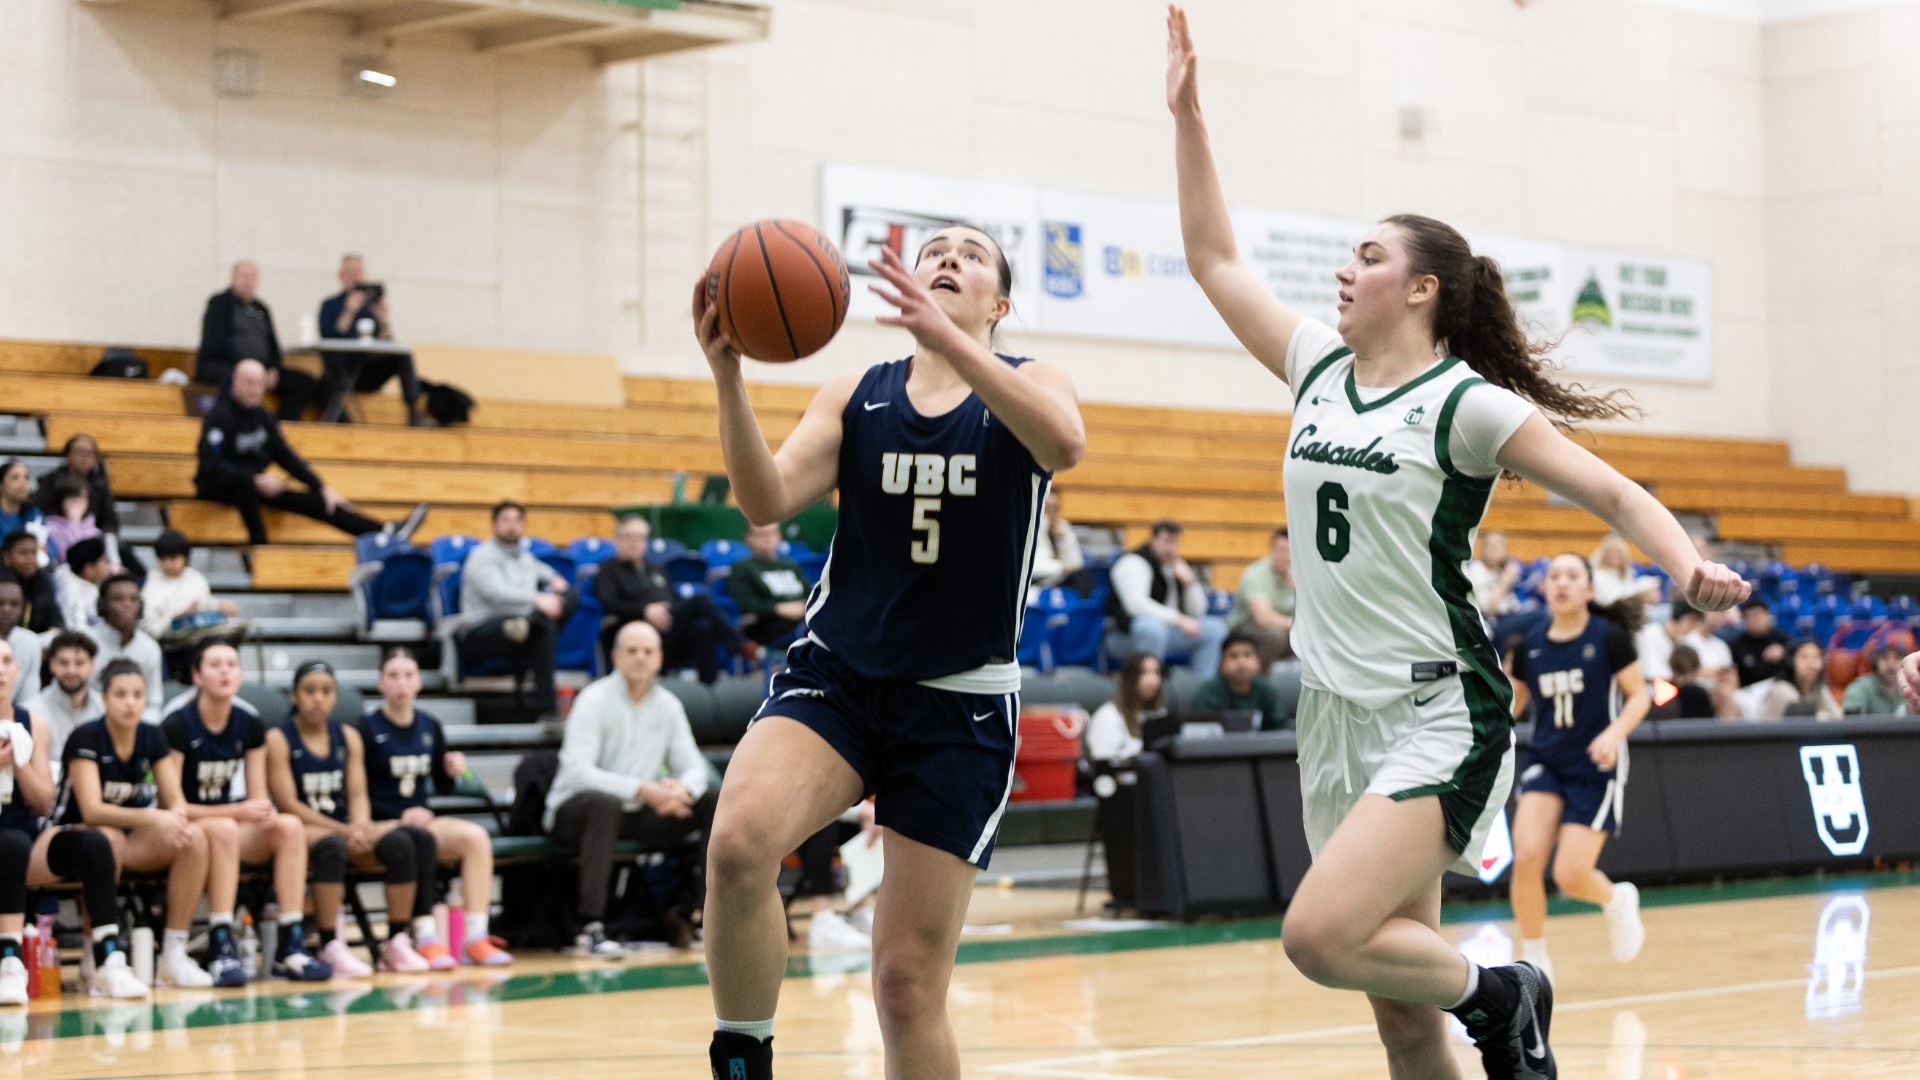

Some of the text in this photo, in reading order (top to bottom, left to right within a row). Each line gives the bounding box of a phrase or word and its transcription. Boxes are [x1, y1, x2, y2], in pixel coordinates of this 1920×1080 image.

[1290, 424, 1399, 474] Cascades
[882, 452, 977, 496] UBC
[911, 497, 941, 564] 5
[1316, 481, 1350, 563] 6
[1538, 668, 1584, 698] UBC
[1553, 692, 1574, 729] 11
